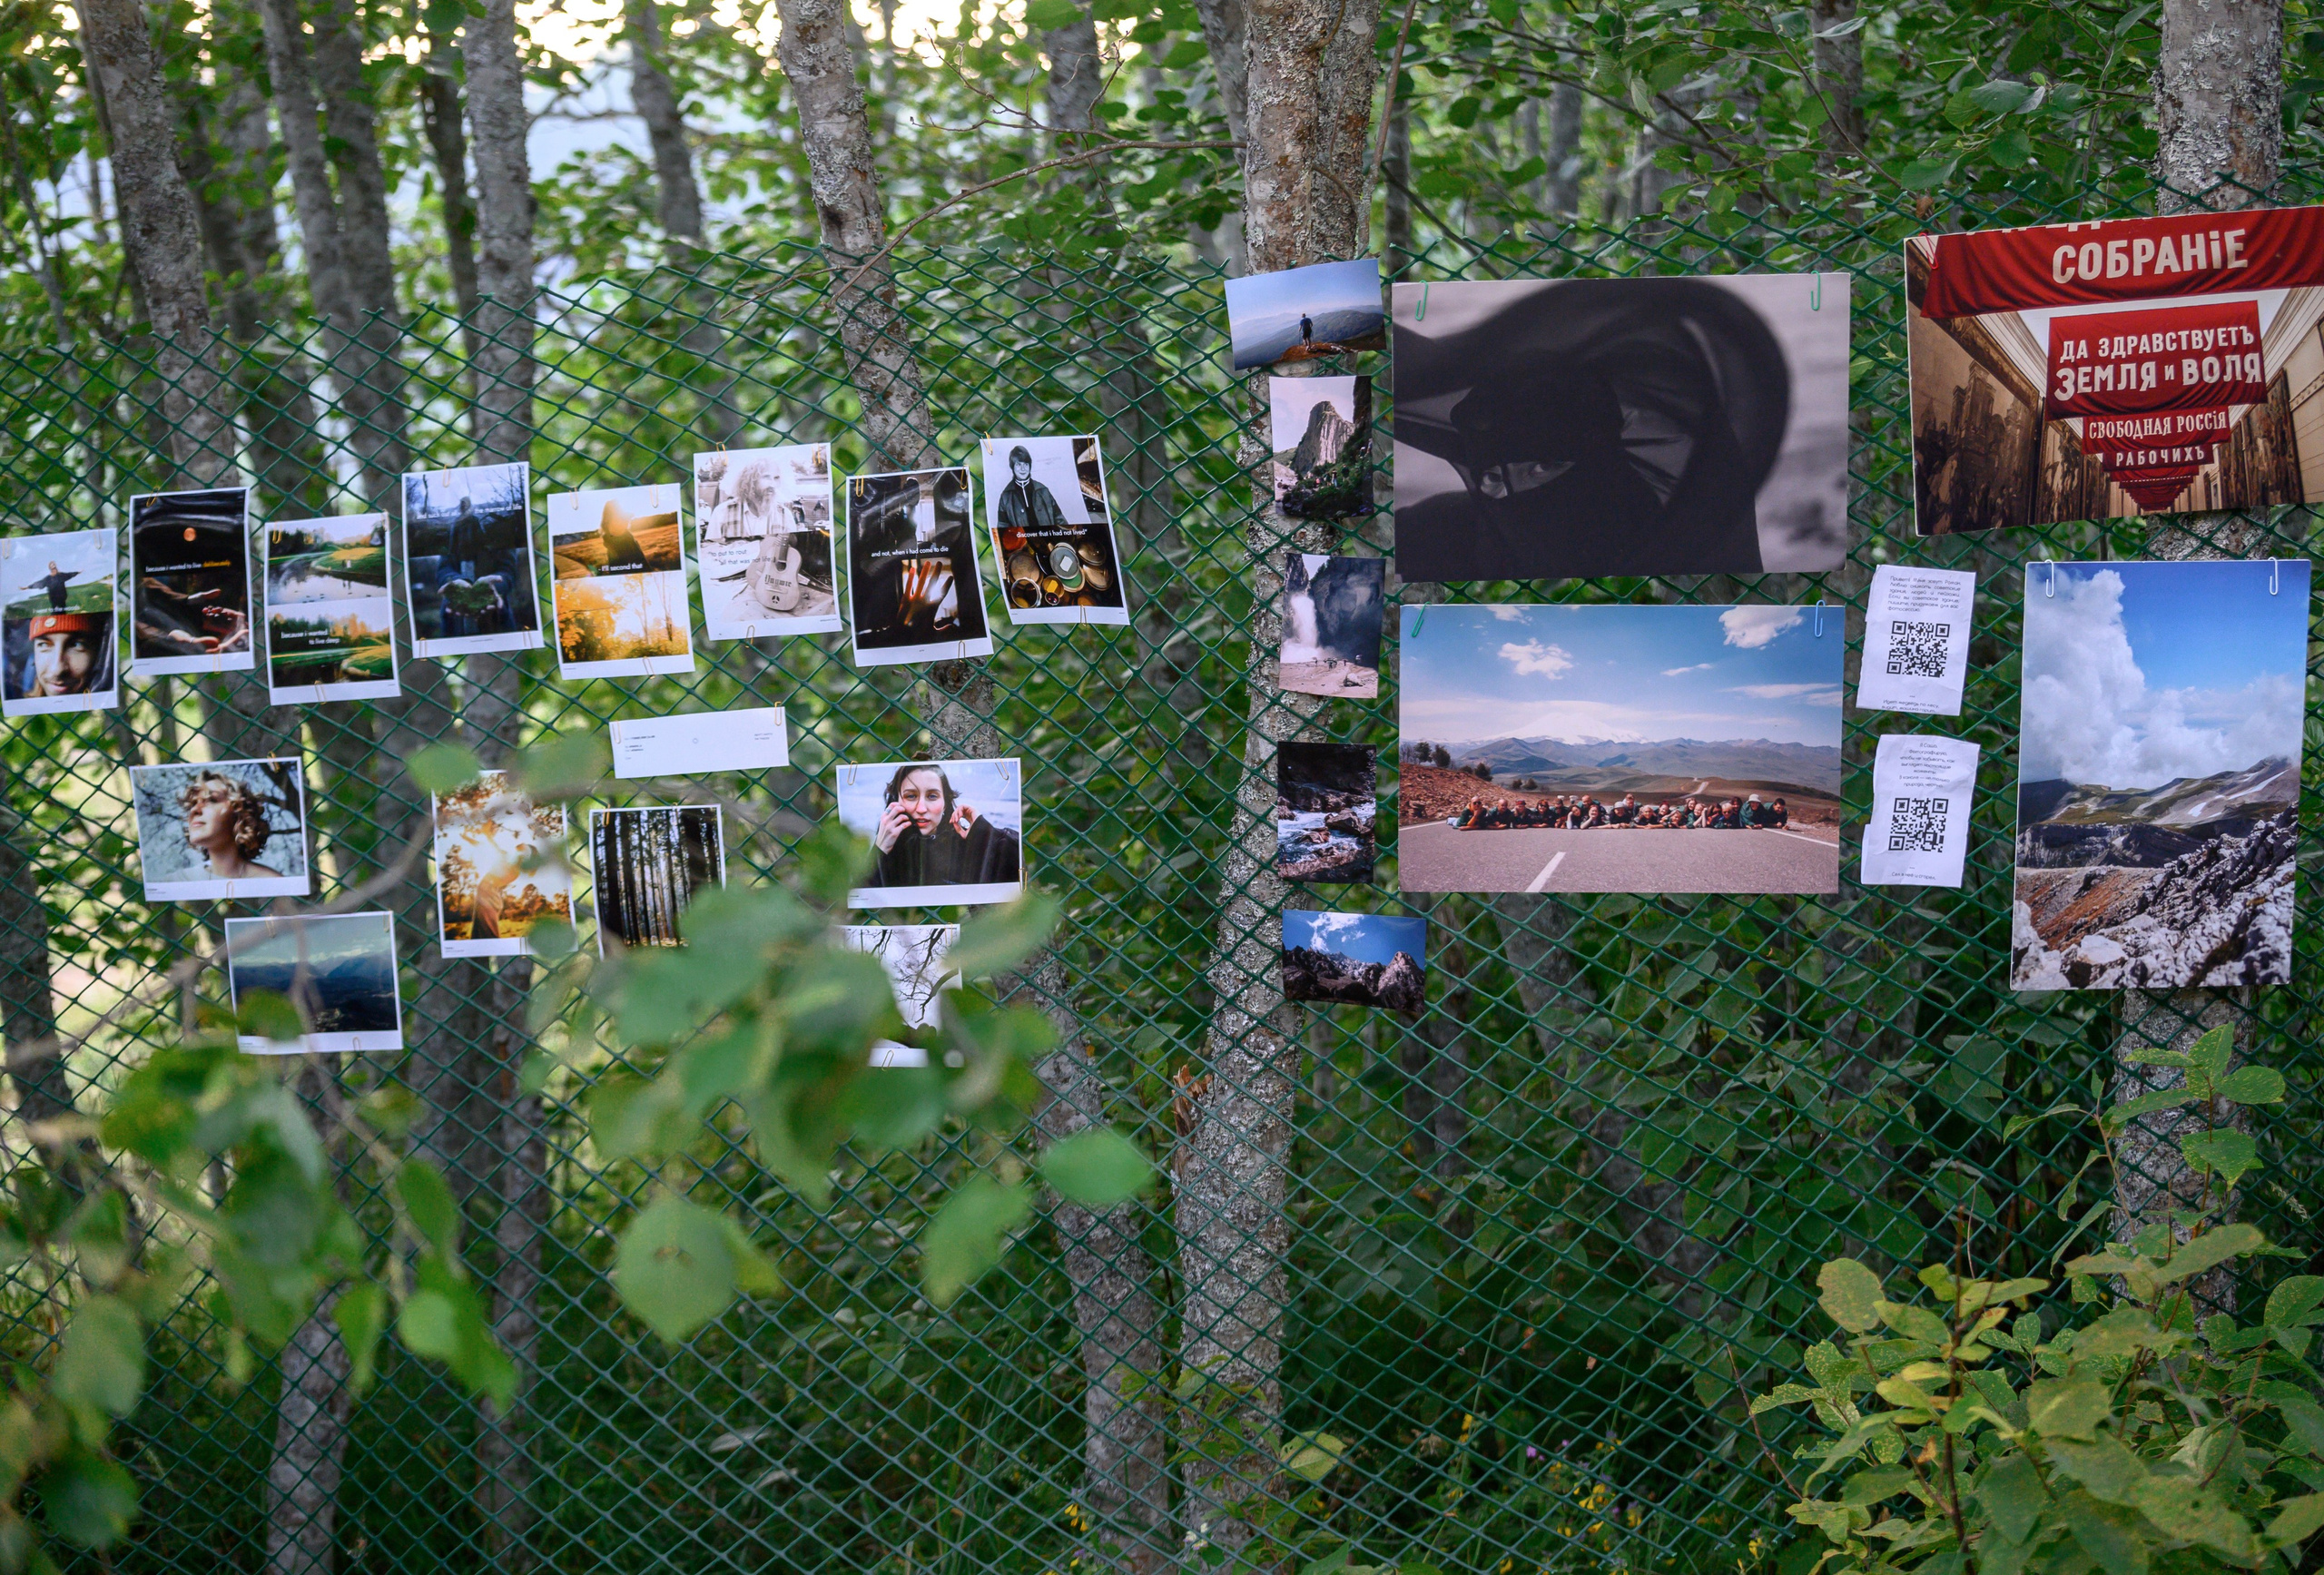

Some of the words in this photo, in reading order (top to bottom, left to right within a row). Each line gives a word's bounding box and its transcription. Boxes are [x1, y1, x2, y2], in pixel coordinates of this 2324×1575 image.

[2060, 340, 2088, 363] ДА
[2098, 326, 2254, 359] ЗДРАВСТВУЕТЪ
[2053, 361, 2156, 401] ЗЕМЛЯ
[2182, 353, 2262, 386] ВОЛЯ
[2089, 417, 2171, 439] СВОБОДНАЯ
[2115, 445, 2204, 467] РАБОЧИХЪ
[610, 563, 631, 571] second
[309, 628, 328, 636] wanted
